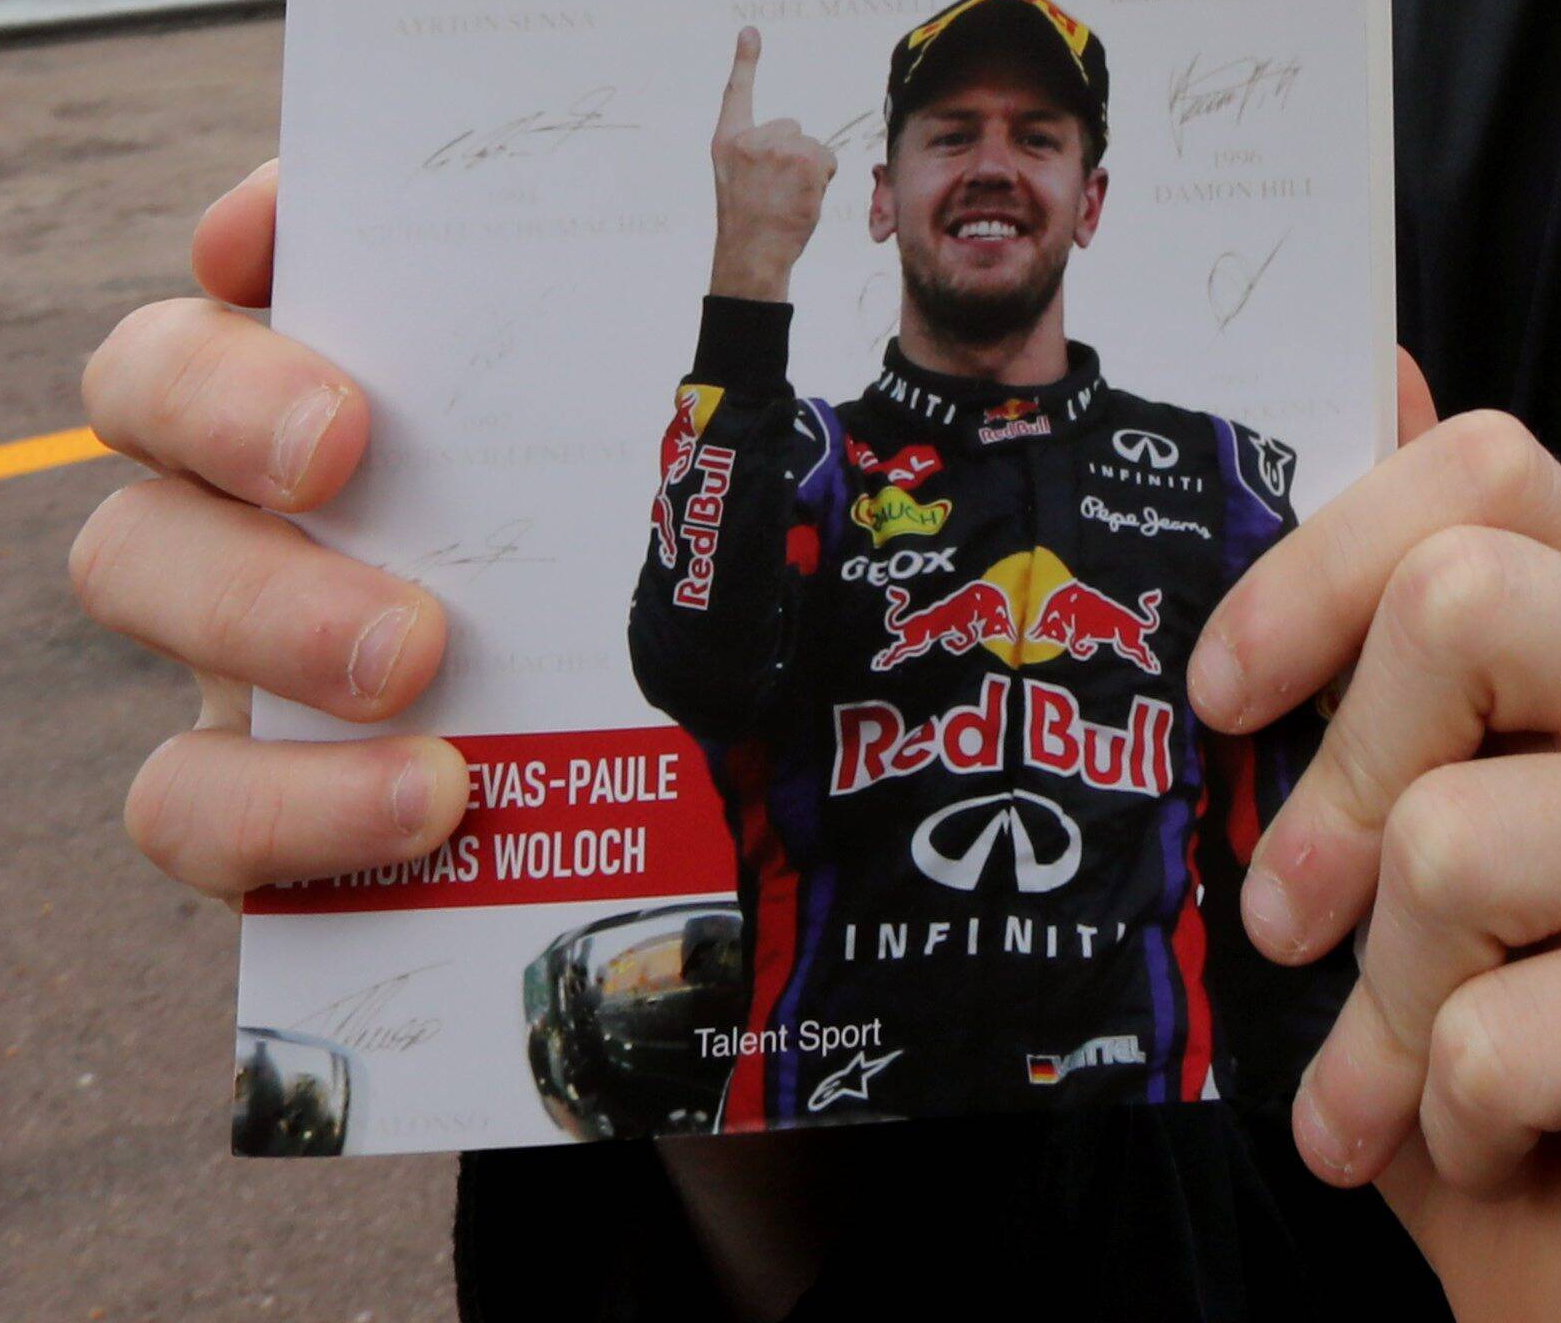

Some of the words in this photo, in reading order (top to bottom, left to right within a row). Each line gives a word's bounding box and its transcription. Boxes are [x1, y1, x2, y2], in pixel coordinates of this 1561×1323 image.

[1152, 181, 1252, 206] DAMON
[684, 443, 737, 527] Bull
[1088, 461, 1204, 494] INFINITI
[1079, 494, 1140, 533] Pepe
[1140, 506, 1213, 540] Jeans
[672, 523, 719, 611] Red
[841, 546, 958, 587] GEOX
[829, 671, 1011, 797] Red
[1023, 677, 1174, 798] Bull
[493, 826, 647, 881] WOLOCH
[694, 1022, 788, 1059] Talent
[798, 1016, 883, 1059] Sport
